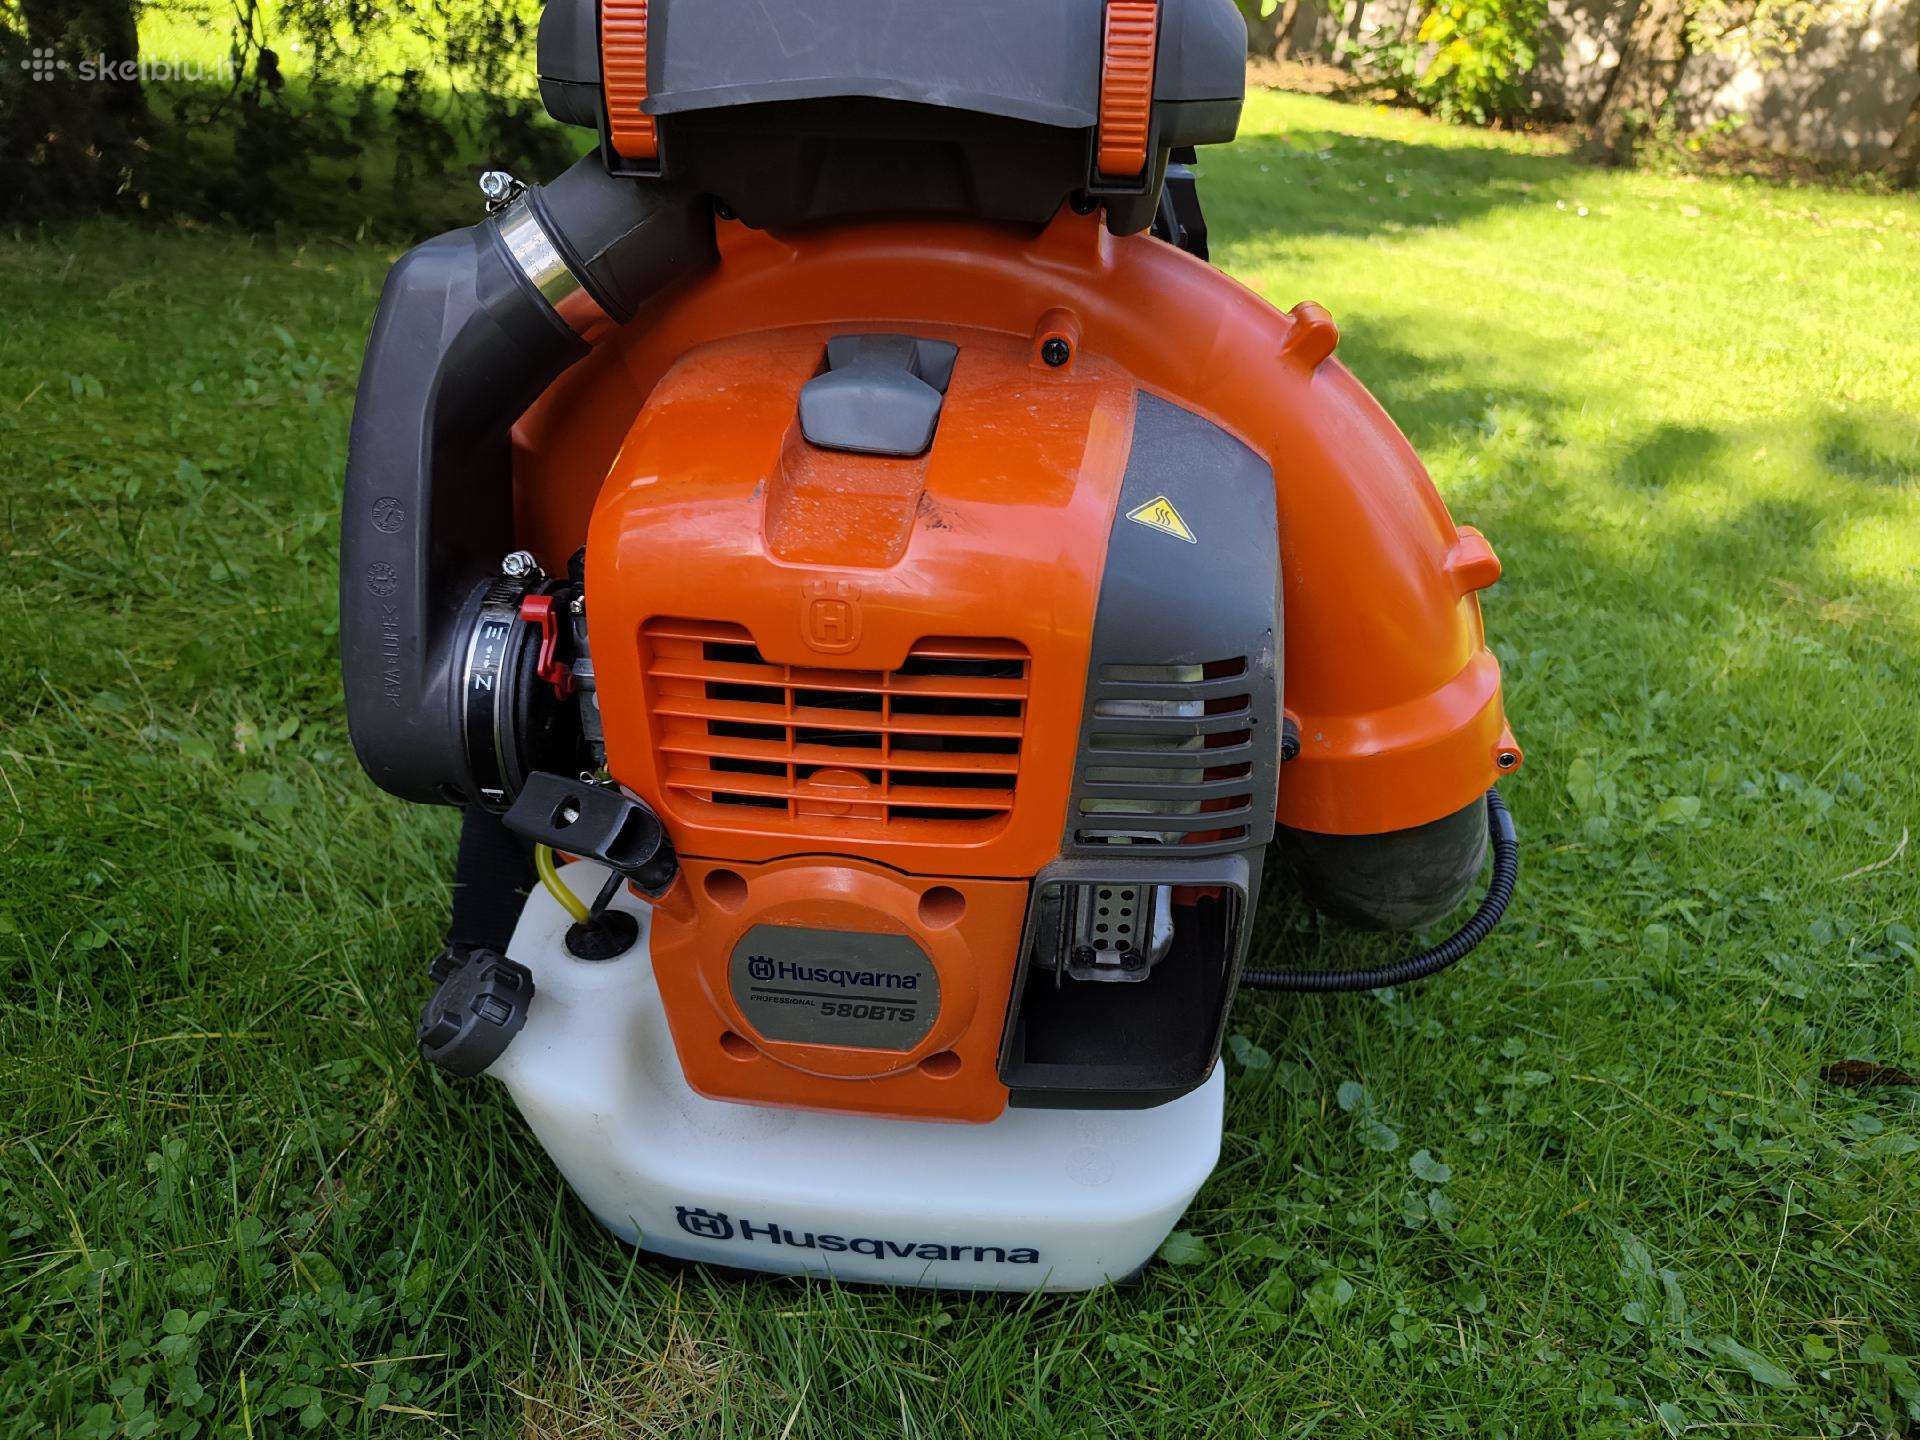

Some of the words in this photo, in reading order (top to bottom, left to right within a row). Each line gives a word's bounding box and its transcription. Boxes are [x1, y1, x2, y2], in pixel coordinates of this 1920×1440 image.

[778, 961, 918, 990] Husqvarna
[750, 994, 816, 1007] PROFESSIONAL
[820, 1001, 916, 1023] 580BTS
[739, 1219, 1040, 1264] Husqvarna
